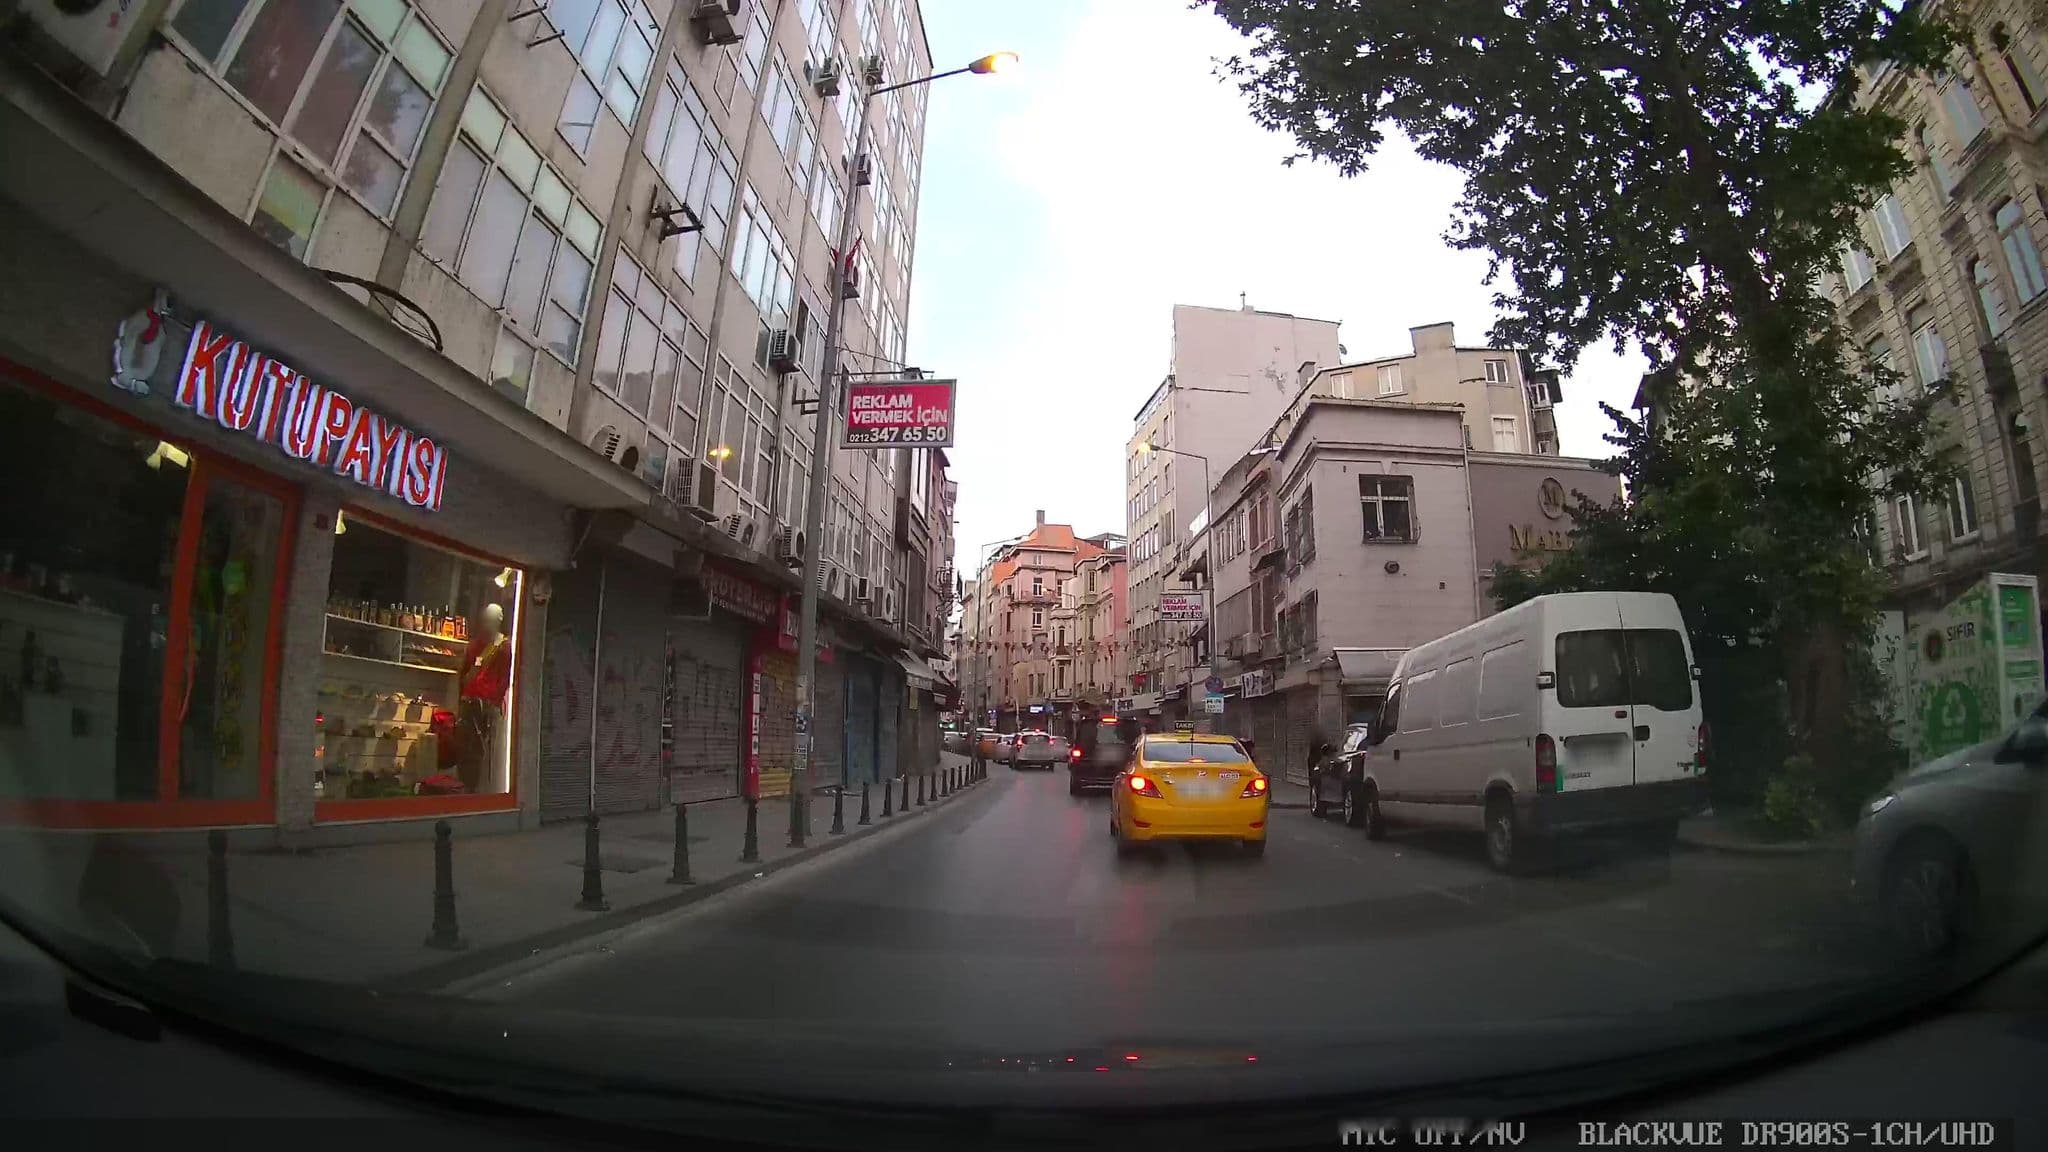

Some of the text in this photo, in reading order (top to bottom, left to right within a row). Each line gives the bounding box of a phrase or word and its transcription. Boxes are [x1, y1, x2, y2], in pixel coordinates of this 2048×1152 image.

[852, 394, 913, 410] REKLAM
[852, 405, 948, 427] VERMEK İÇİN
[870, 427, 899, 442] 347
[902, 427, 922, 442] 65
[926, 426, 946, 442] 50
